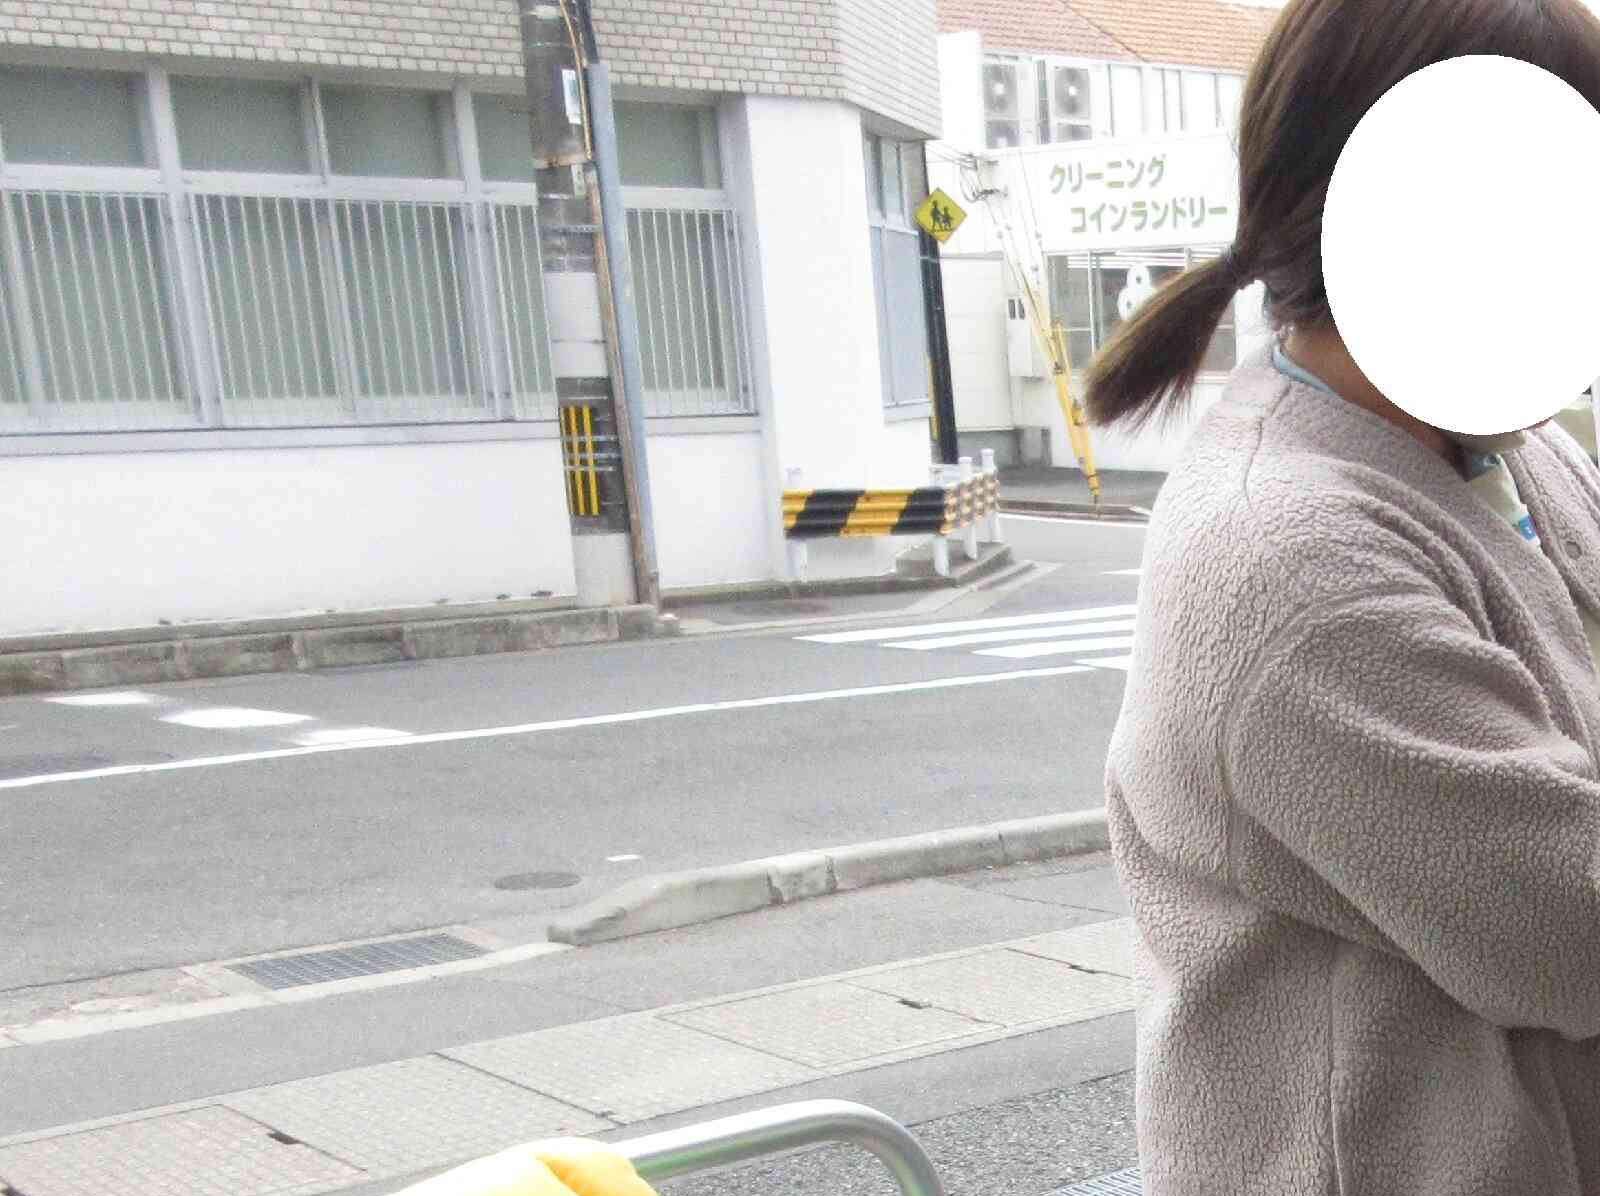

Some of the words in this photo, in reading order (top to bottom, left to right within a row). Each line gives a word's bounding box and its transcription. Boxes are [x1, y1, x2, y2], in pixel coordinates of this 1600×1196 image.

[1049, 154, 1167, 195] クリーニング
[1070, 196, 1228, 234] コインランドリー
